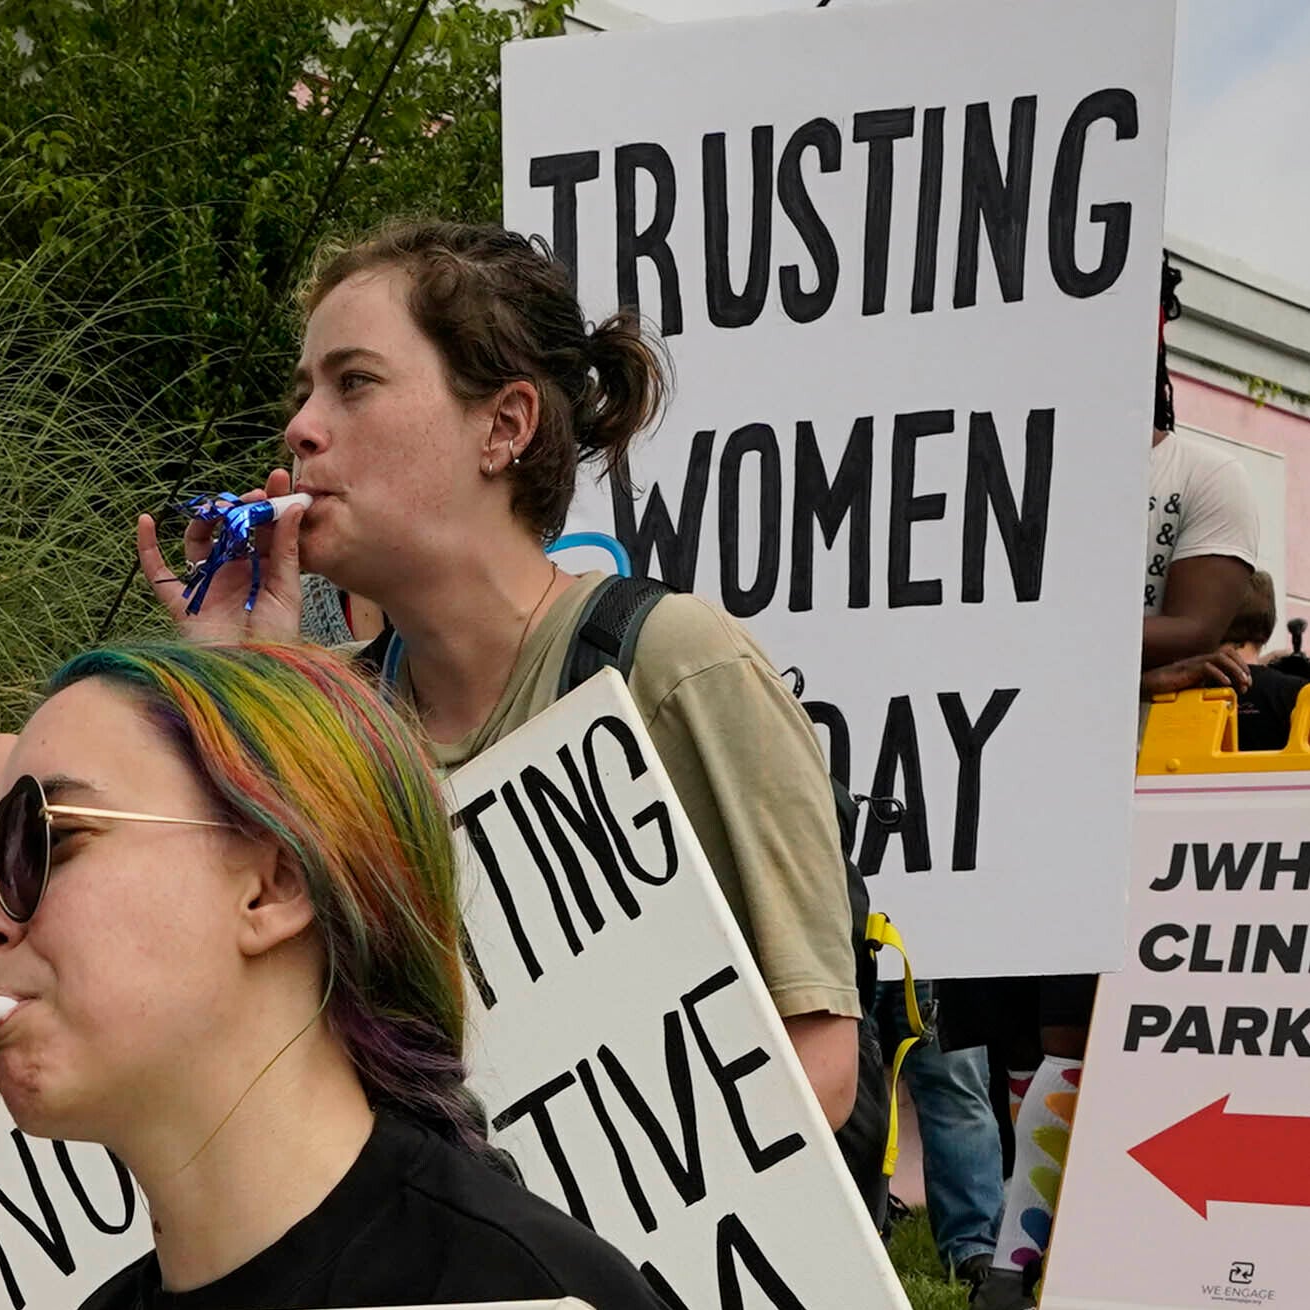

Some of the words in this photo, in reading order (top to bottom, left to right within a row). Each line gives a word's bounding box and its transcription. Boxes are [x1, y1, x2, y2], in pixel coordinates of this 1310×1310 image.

[529, 87, 1139, 337] TRUSTING
[612, 407, 1055, 618] WOMEN
[450, 714, 679, 1010] TING
[1148, 840, 1310, 892] JWH
[1138, 922, 1310, 974] CLIN
[1123, 1004, 1310, 1058] PARK
[1201, 1285, 1222, 1296] WE
[1224, 1286, 1276, 1301] ENGAGE
